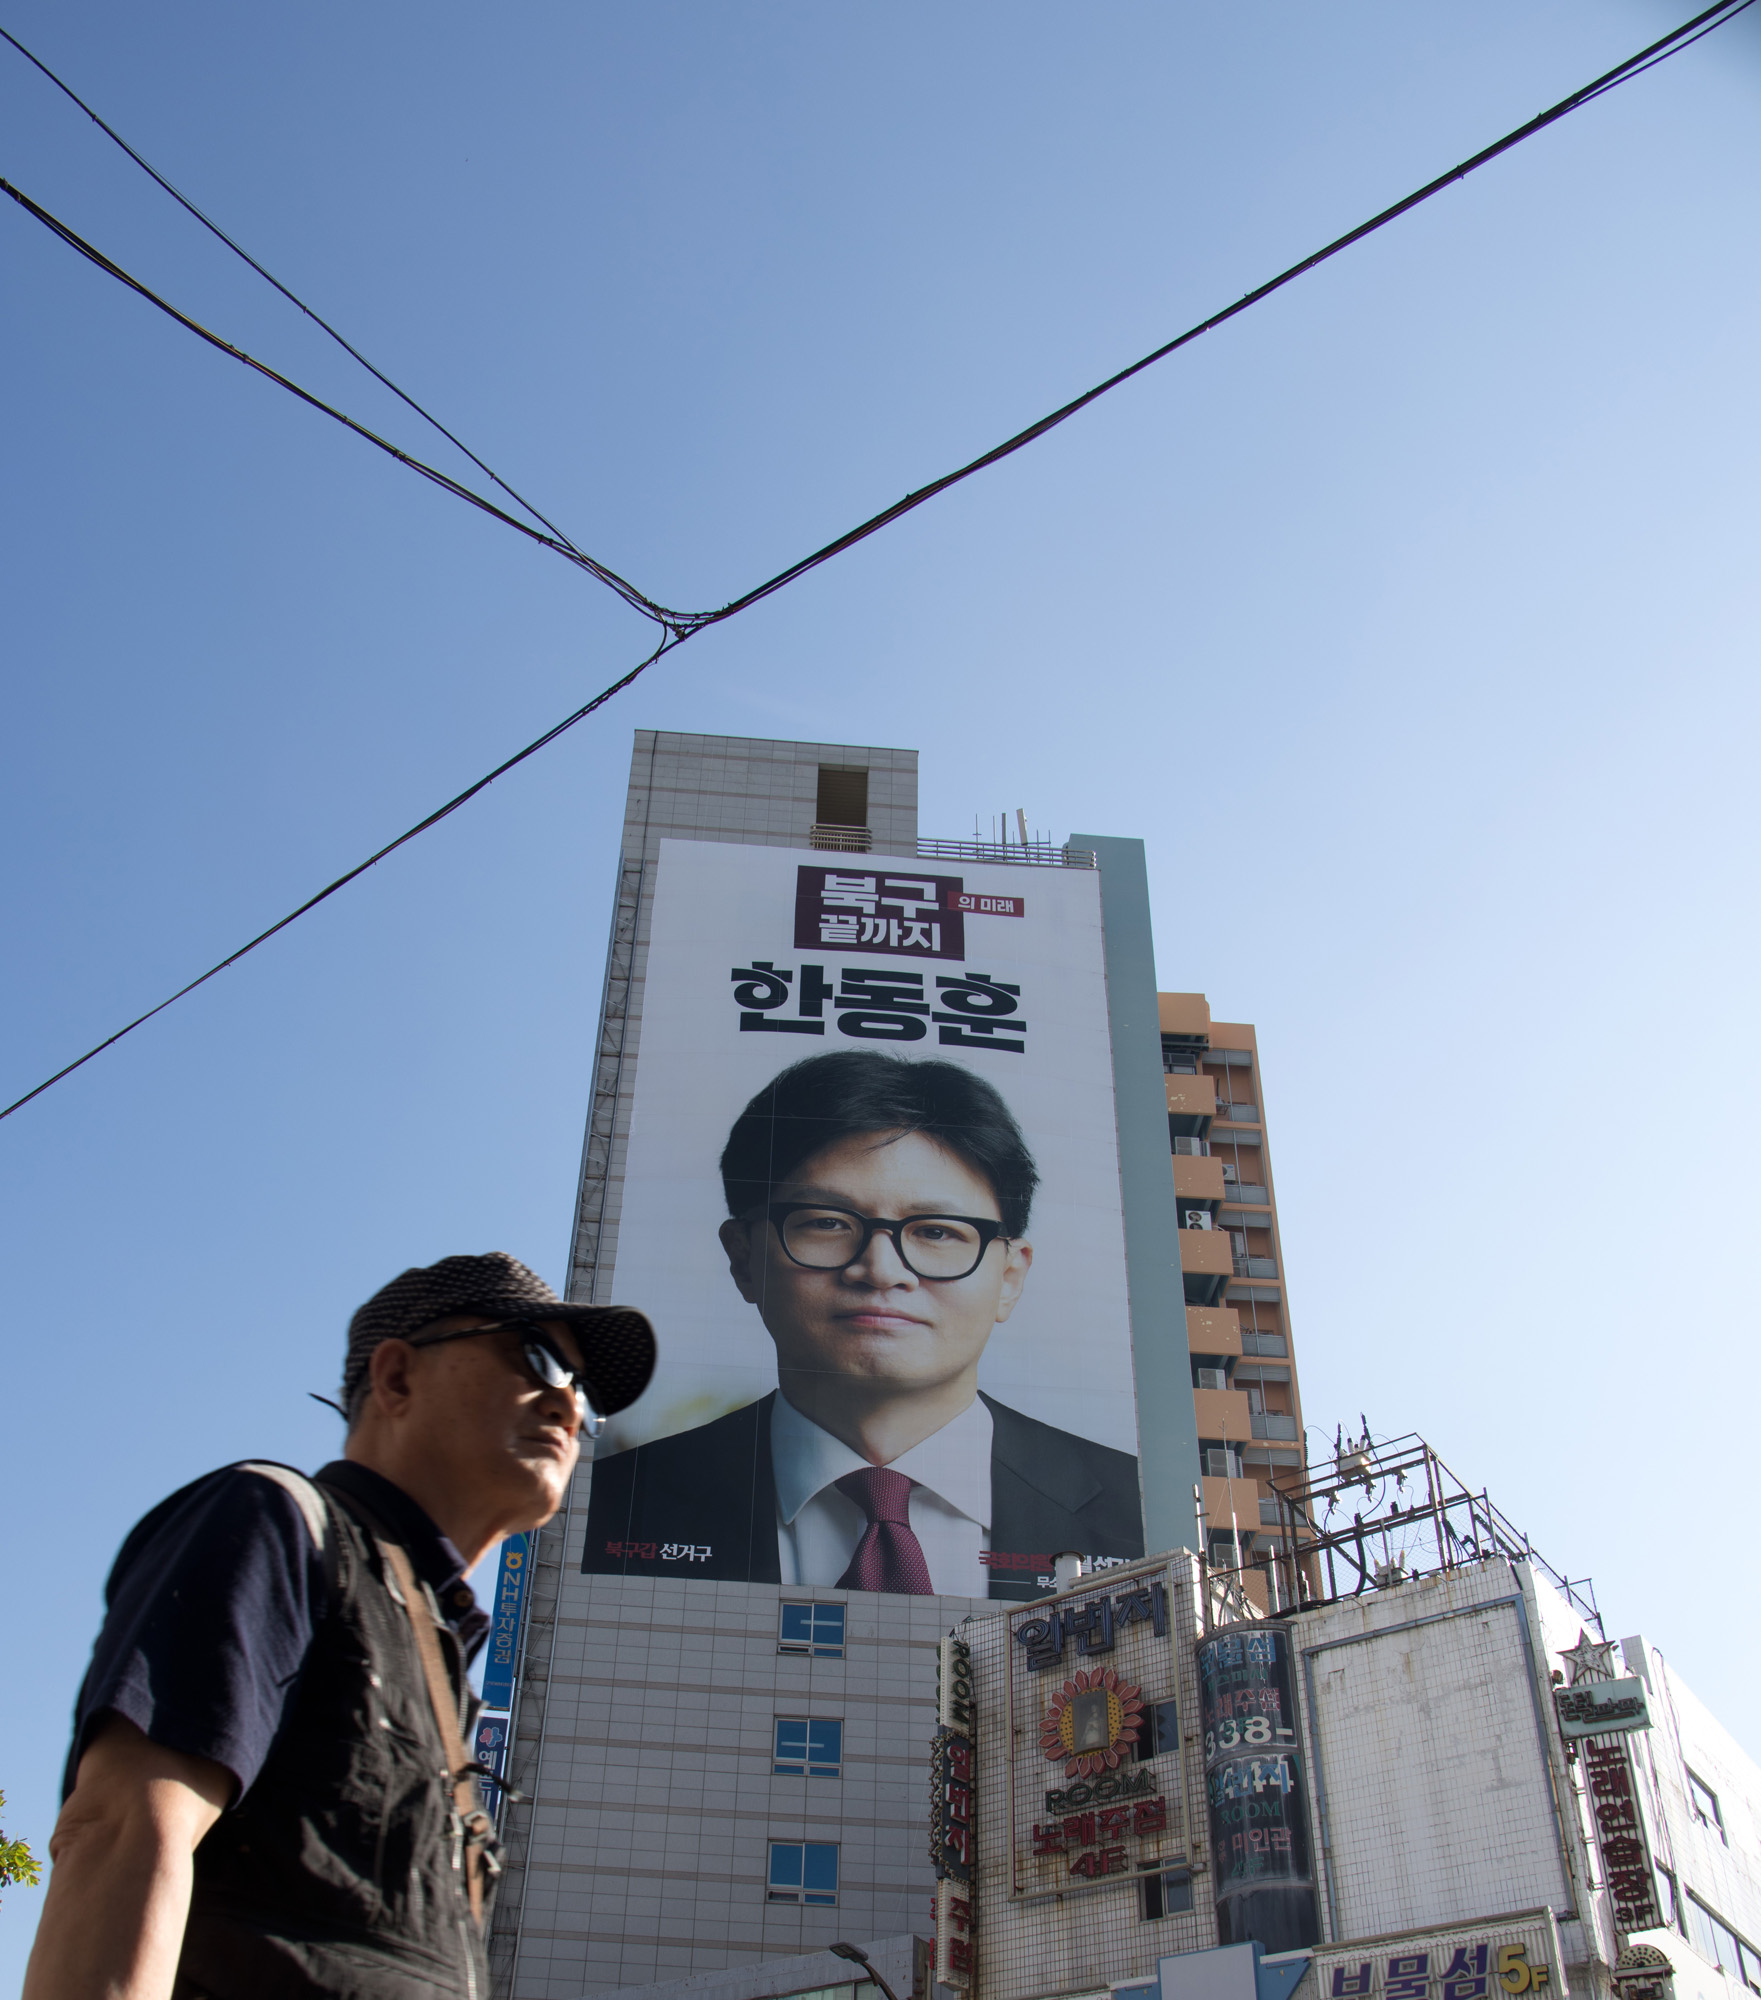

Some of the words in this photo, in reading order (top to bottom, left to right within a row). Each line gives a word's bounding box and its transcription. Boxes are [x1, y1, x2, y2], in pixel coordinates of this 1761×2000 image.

[820, 874, 939, 918] 북구
[958, 896, 975, 910] 의
[980, 898, 1014, 914] 미래
[818, 915, 941, 952] 끝까지
[730, 961, 1027, 1054] 한동훈
[604, 1540, 657, 1560] 북구갑
[659, 1543, 713, 1562] 선거구
[979, 1550, 1055, 1572] 국회의원
[493, 1571, 521, 1664] NH투자증권
[1016, 1581, 1166, 1672] 일번지
[950, 1638, 970, 1725] ROOM
[943, 1744, 970, 1867] 일번지
[1045, 1768, 1150, 1812] ROOM
[1033, 1796, 1167, 1856] 노래주점
[1586, 1738, 1651, 1902] 노래연습장
[1070, 1845, 1126, 1878] 4F
[949, 1896, 973, 1976] 주점
[1616, 1903, 1654, 1923] 3F
[1498, 1943, 1549, 1994] 5F
